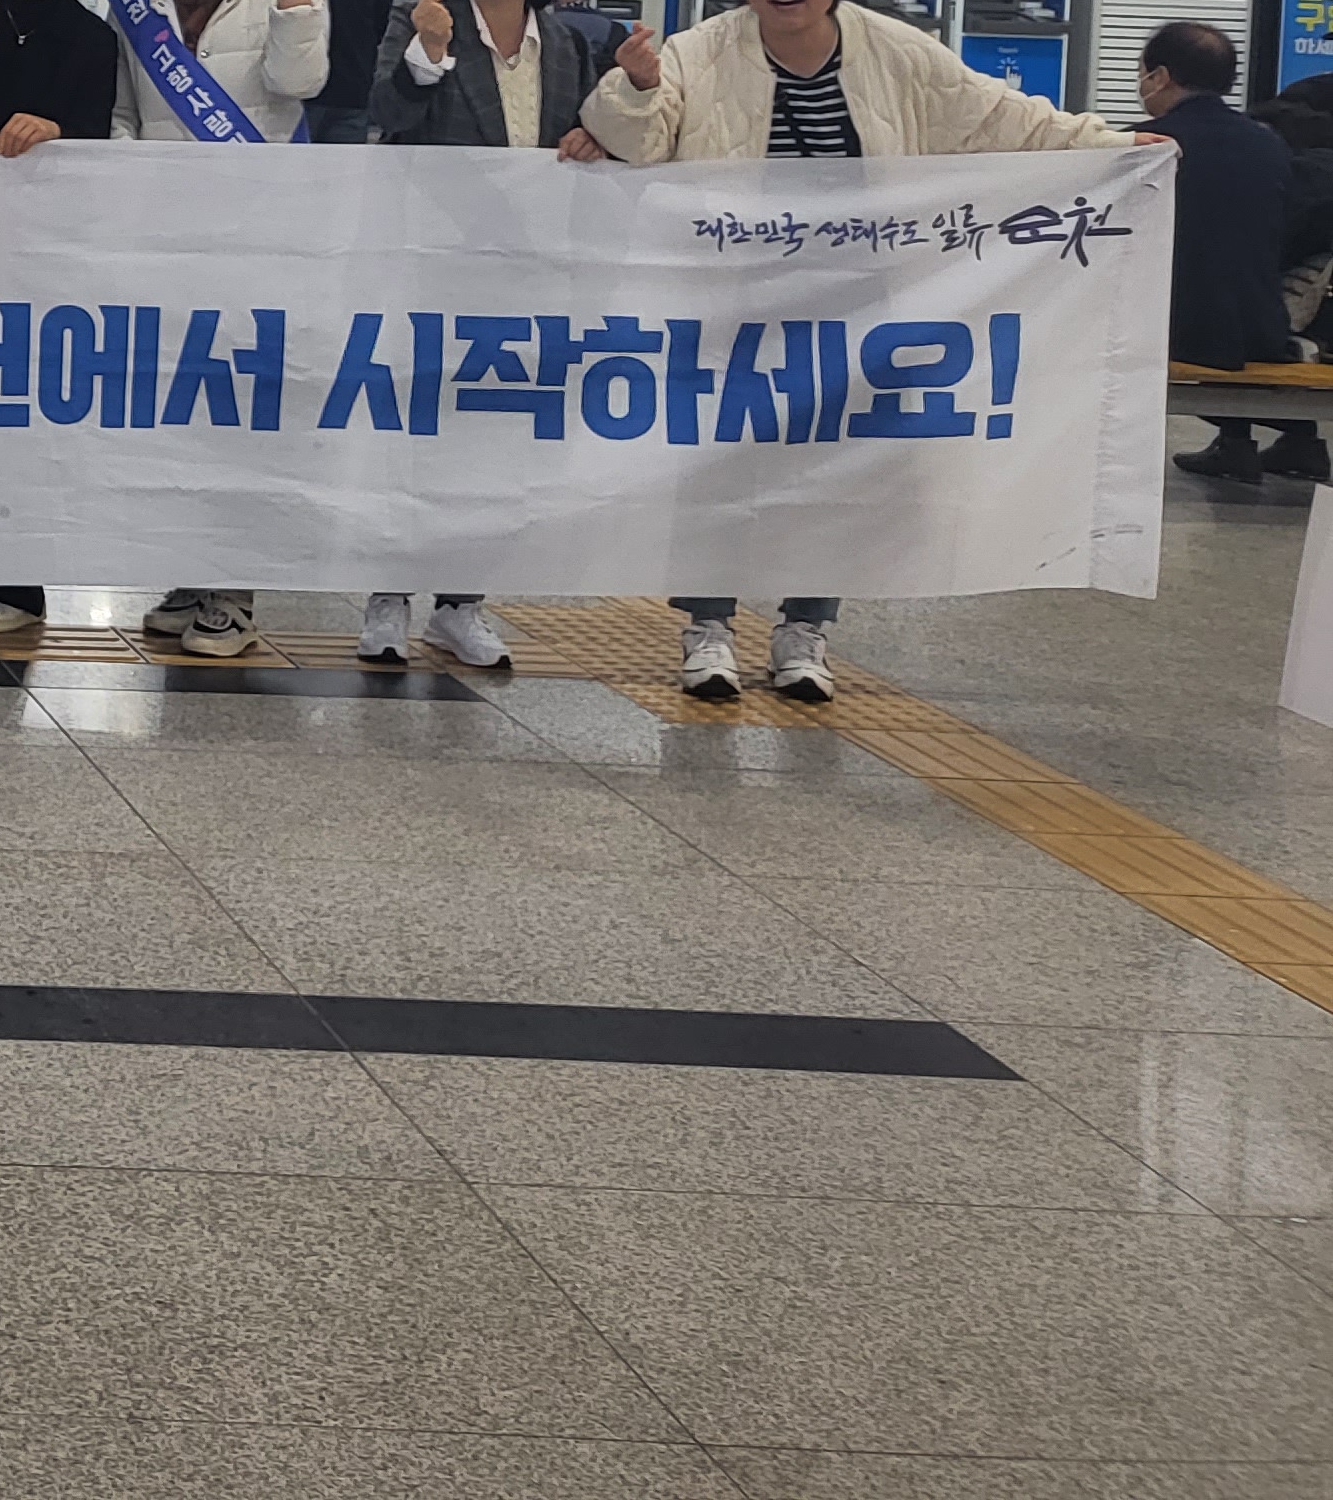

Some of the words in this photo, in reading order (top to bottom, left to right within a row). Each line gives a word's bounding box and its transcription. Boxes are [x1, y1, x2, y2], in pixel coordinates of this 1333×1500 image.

[152, 43, 248, 143] 고향사랑
[694, 210, 811, 257] 대한민국
[932, 204, 994, 261] 일류
[997, 196, 1134, 267] 순천
[317, 311, 1022, 446] 시작하세요!
